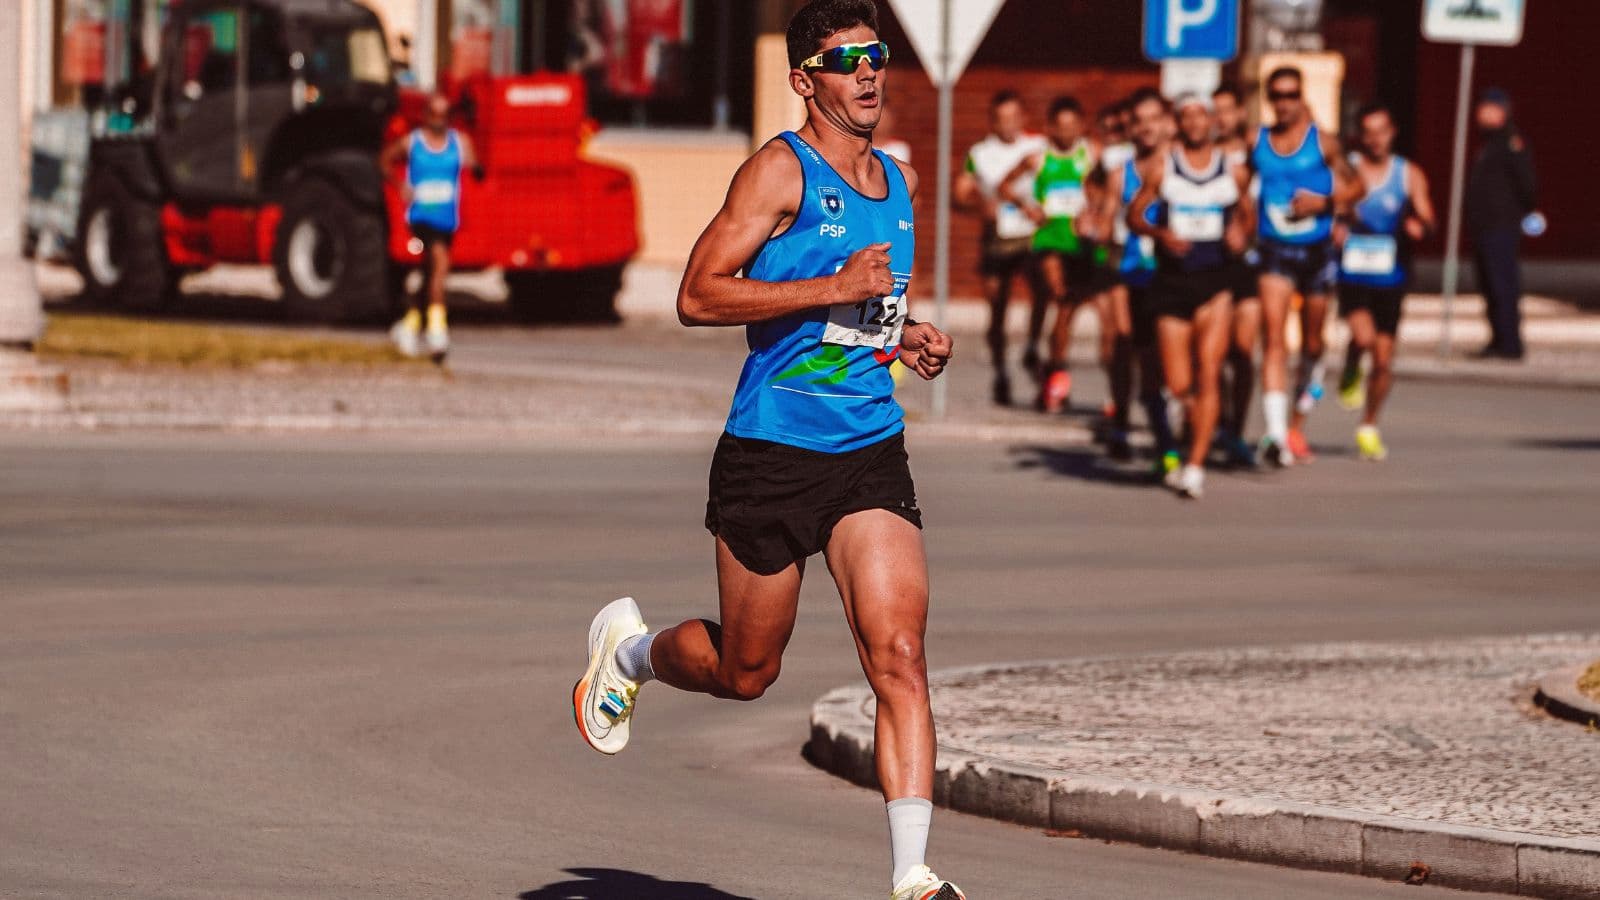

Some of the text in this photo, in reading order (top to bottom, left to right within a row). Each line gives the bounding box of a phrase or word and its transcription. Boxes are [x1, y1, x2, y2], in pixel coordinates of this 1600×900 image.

[1166, 0, 1218, 49] P
[820, 224, 846, 238] PSP
[855, 300, 898, 328] 122
